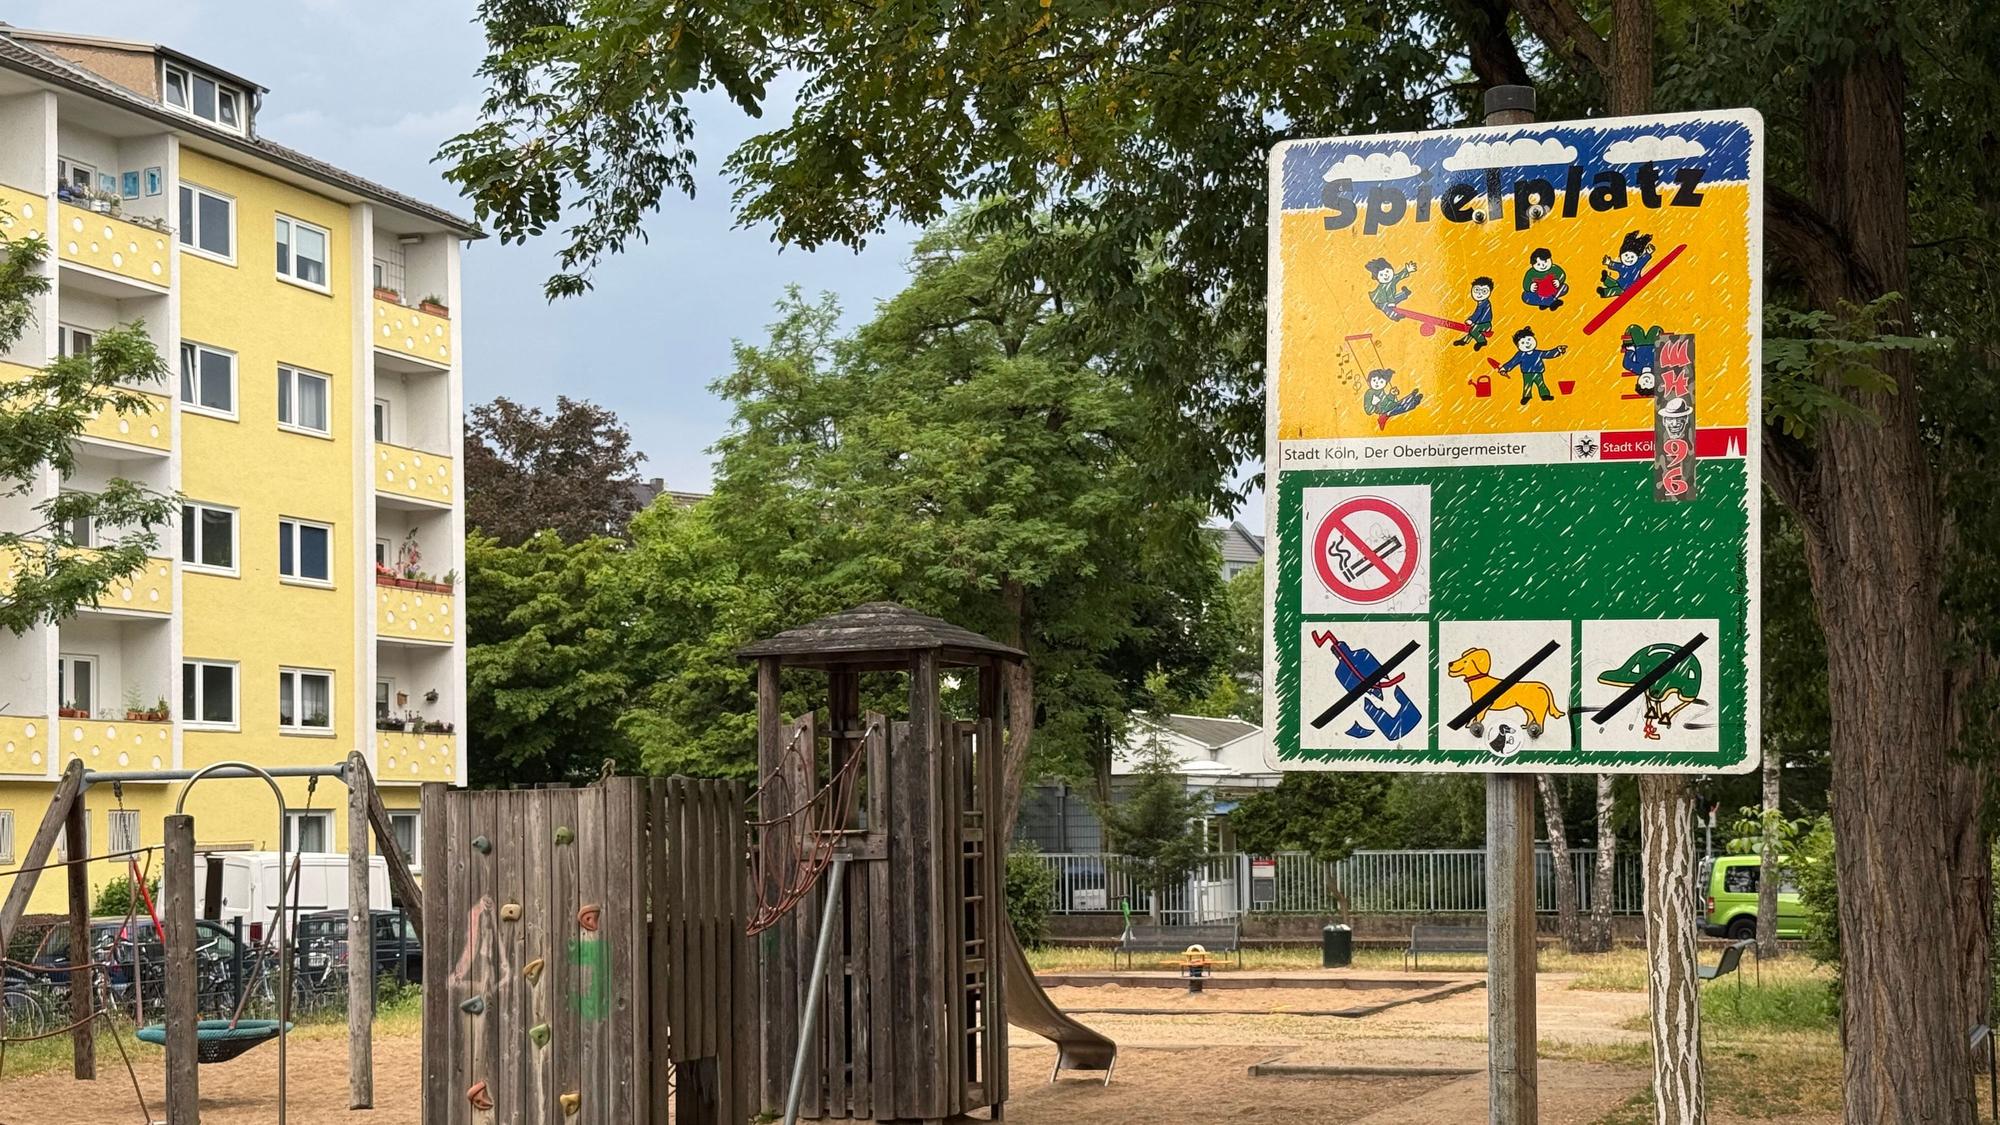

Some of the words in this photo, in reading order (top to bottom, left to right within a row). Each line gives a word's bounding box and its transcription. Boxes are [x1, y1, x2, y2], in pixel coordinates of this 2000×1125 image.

[1323, 161, 1706, 235] Spielplatz
[1284, 448, 1320, 461] Stadt
[1325, 446, 1358, 461] Köln,
[1364, 446, 1389, 458] Der
[1393, 443, 1527, 459] Oberbürgermeister
[1603, 441, 1633, 453] Stadt
[1635, 440, 1656, 452] Köl
[1663, 439, 1688, 496] 96
